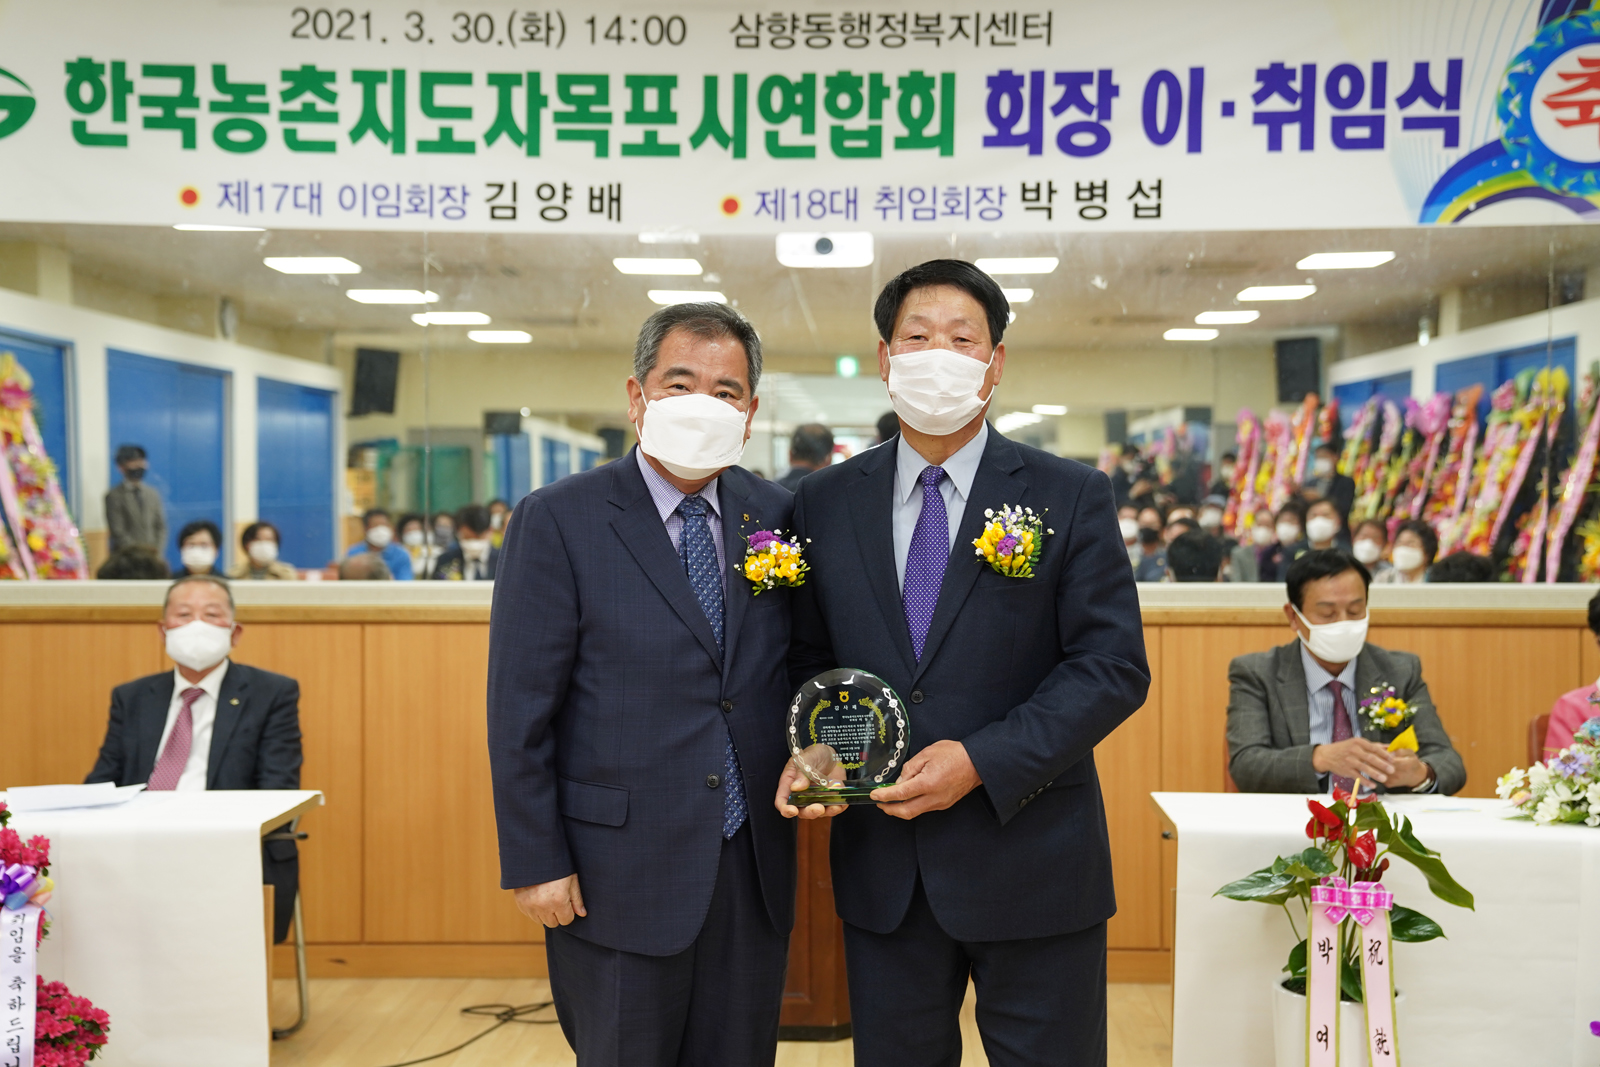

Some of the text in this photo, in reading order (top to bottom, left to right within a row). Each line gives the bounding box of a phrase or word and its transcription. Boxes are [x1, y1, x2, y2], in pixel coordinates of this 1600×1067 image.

[291, 8, 1053, 49] 2021. 3. 30.(화) 14:00 삼향동행정복지센터
[64, 57, 956, 159] 한국농촌지도자목포시연합회
[982, 69, 1120, 157] 회장
[218, 181, 323, 216] 제17대
[337, 183, 471, 219] 이임회장
[754, 187, 859, 221] 제18대
[874, 186, 1007, 221] 취임회장
